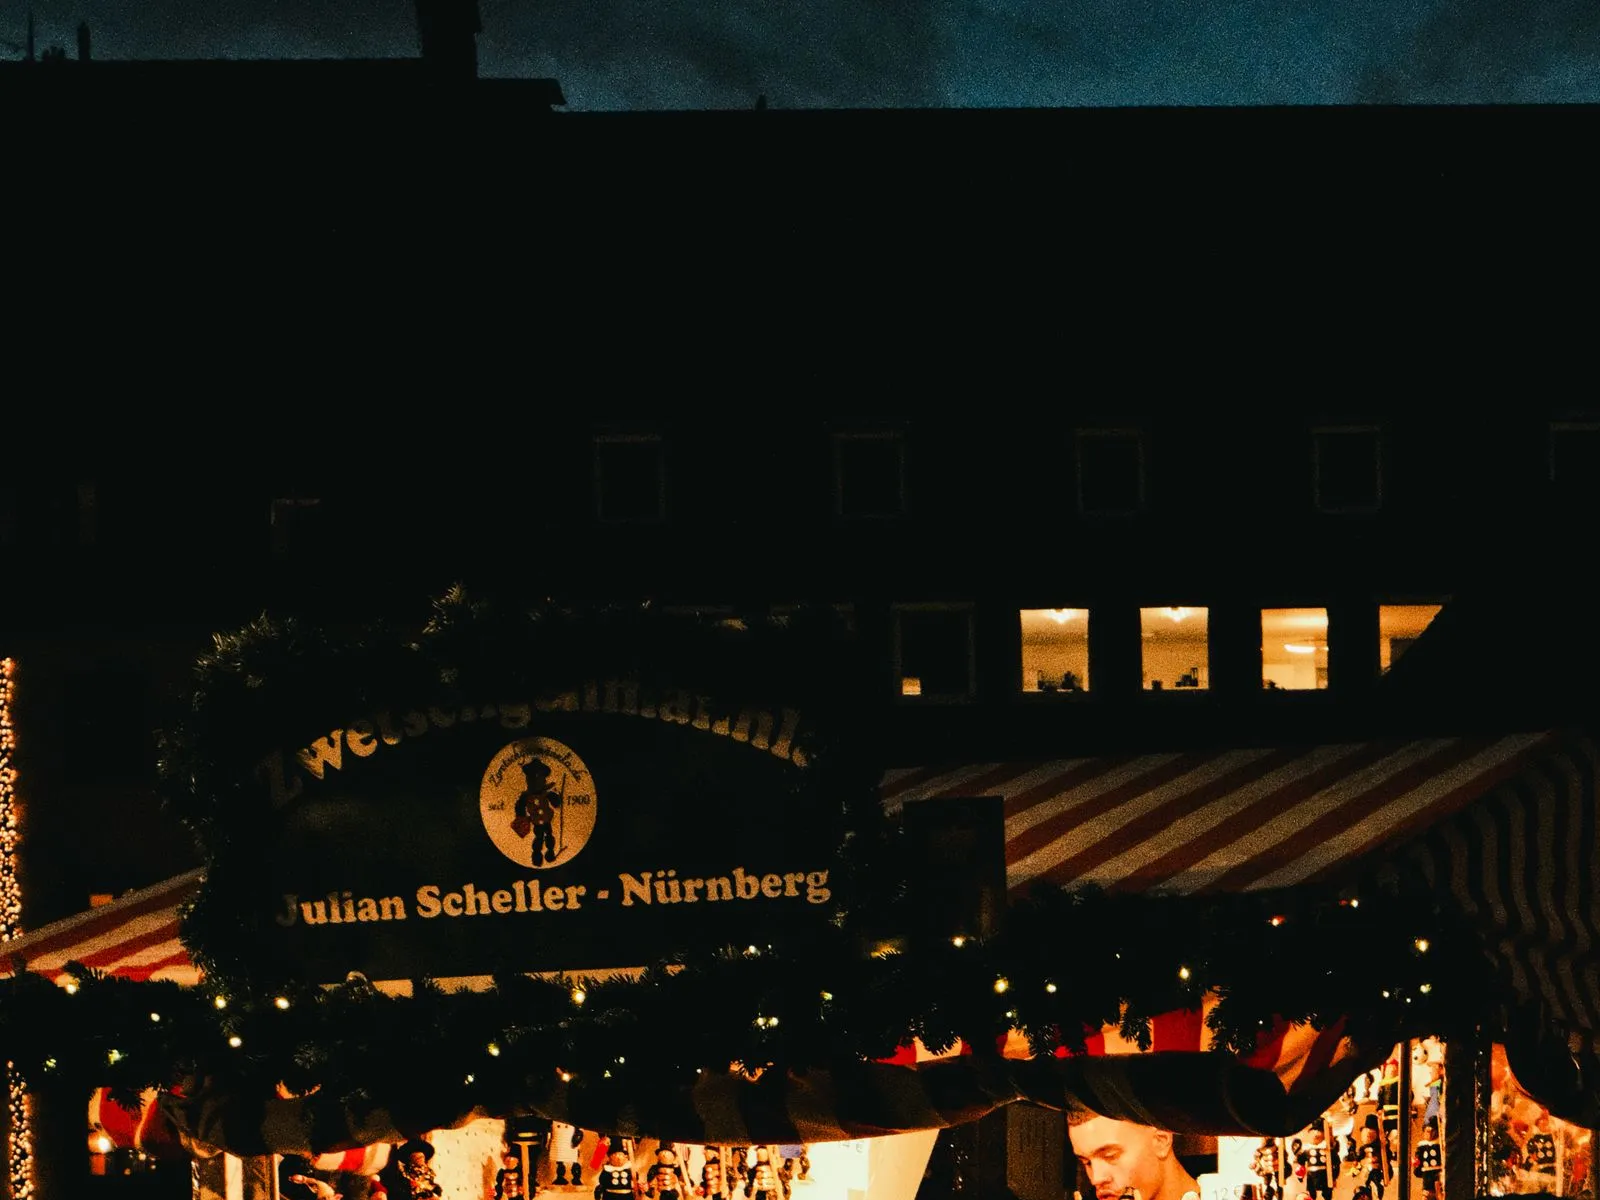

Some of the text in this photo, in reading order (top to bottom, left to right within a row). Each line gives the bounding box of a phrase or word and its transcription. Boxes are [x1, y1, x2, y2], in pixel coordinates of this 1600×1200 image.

[275, 864, 832, 928] Julian Scheller - Nürnberg
[1213, 1187, 1228, 1200] 12
